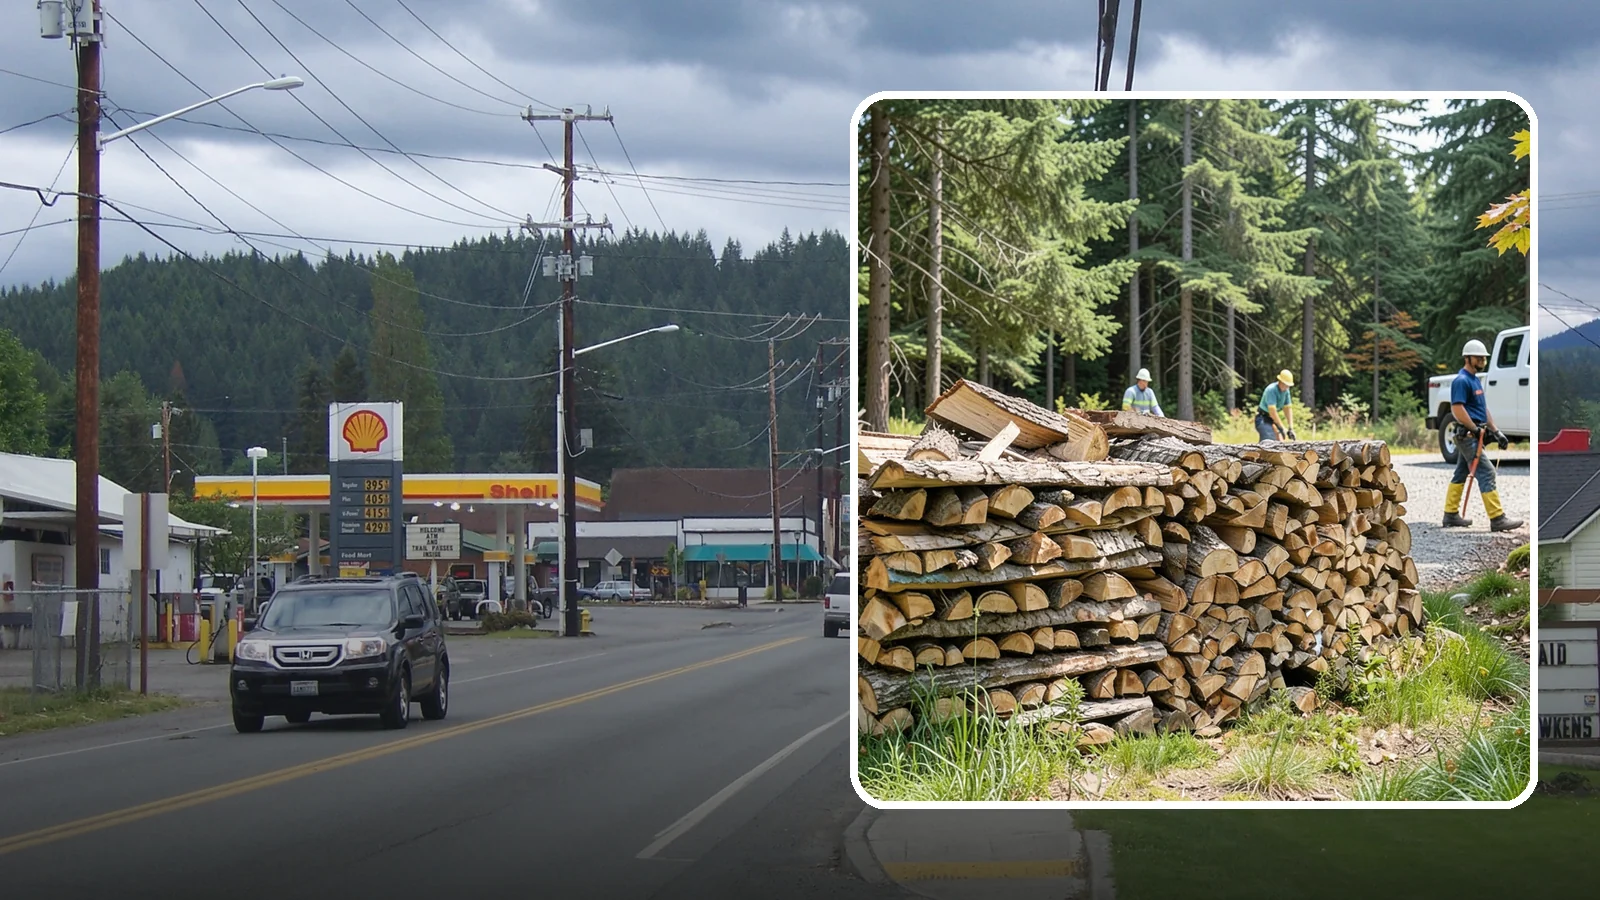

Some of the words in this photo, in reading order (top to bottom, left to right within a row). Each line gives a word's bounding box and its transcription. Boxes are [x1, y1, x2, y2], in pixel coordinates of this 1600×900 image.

[366, 480, 383, 490] 395
[490, 484, 547, 499] Shell
[366, 494, 383, 504] 405
[366, 508, 383, 518] 415
[366, 522, 383, 532] 429
[1539, 642, 1567, 665] AID
